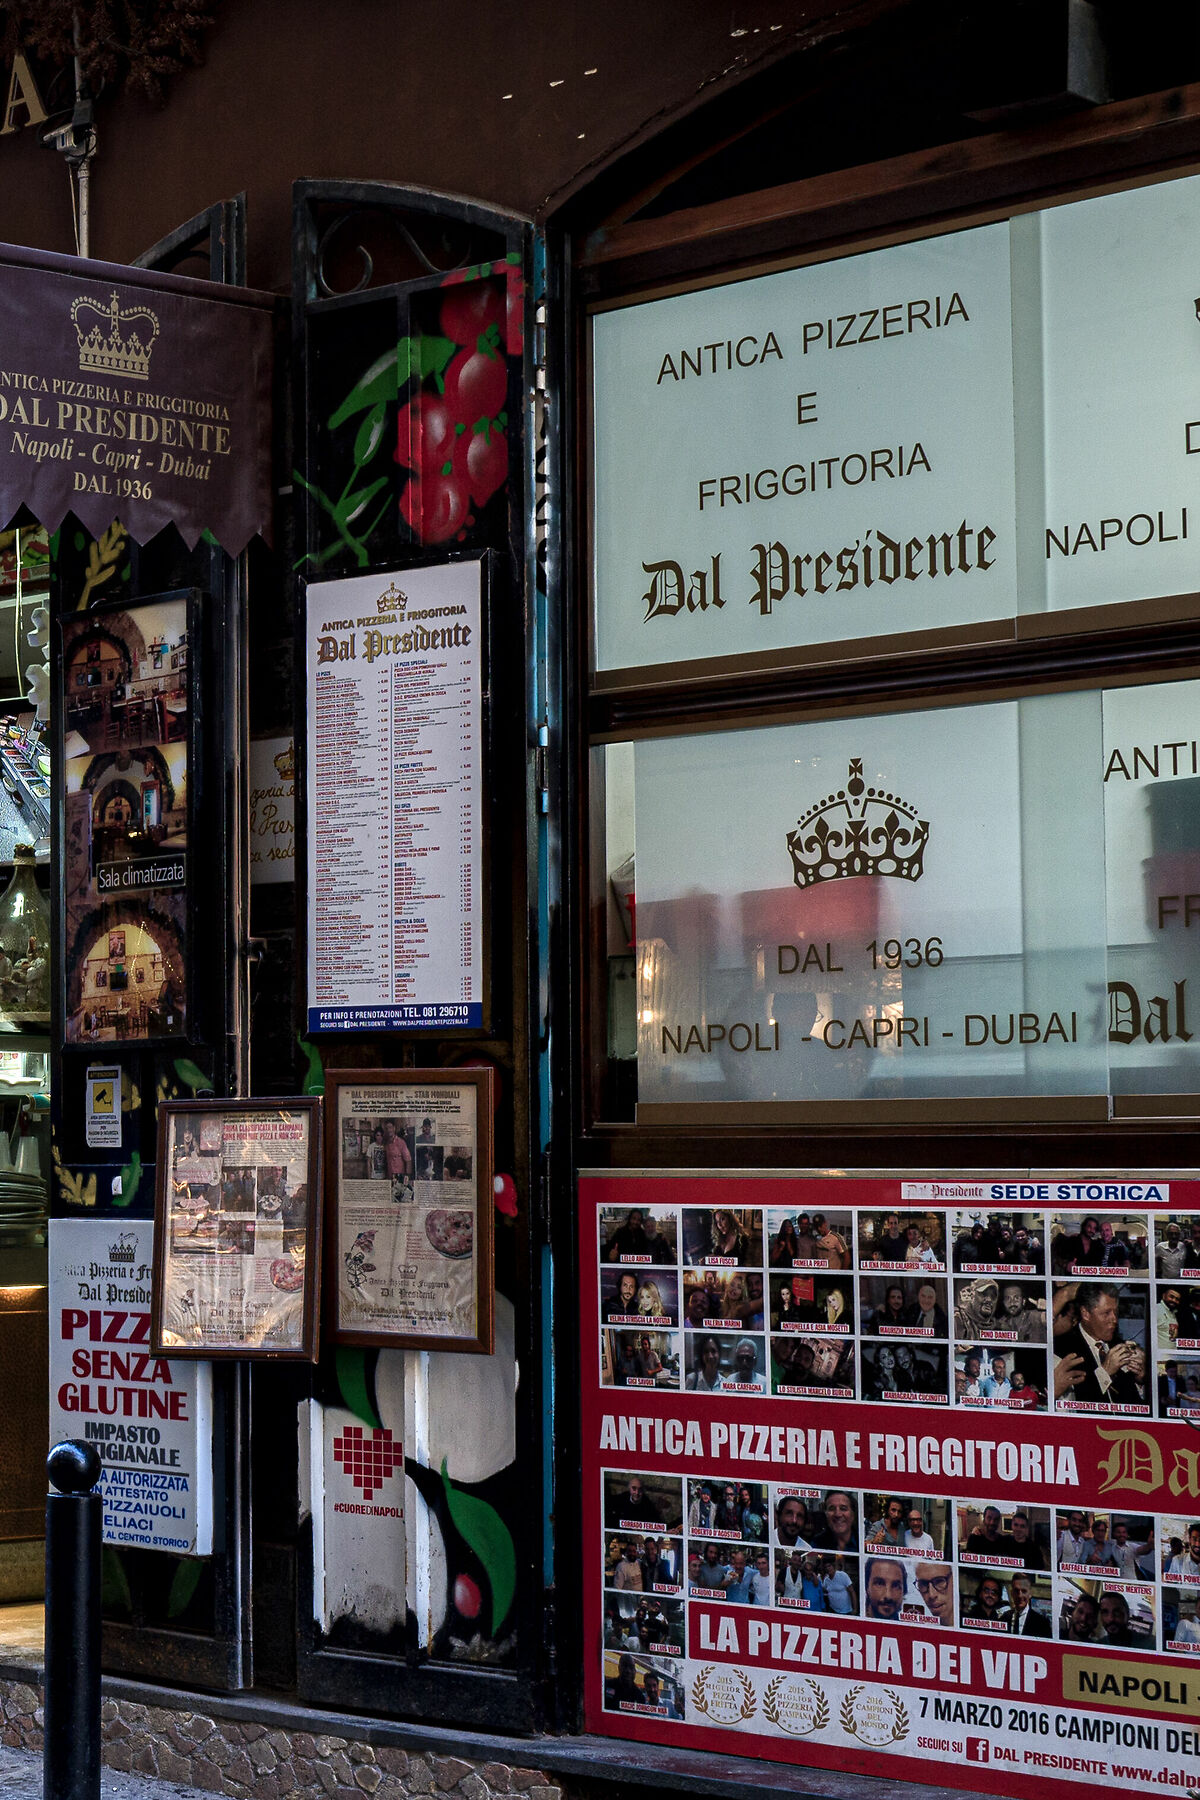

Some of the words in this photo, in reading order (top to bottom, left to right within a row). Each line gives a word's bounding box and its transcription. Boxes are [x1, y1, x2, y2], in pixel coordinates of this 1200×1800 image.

[657, 331, 784, 385] ANTICA
[802, 292, 970, 354] PIZZERIA
[53, 379, 120, 404] PIZZERIA
[124, 390, 133, 405] E
[136, 392, 230, 421] FRIGGITORIA
[796, 392, 818, 424] E
[56, 401, 232, 455] PRESIDENTE
[10, 432, 74, 463] Napoli
[92, 443, 142, 473] Capri
[158, 452, 212, 480] Dubai
[699, 442, 932, 511] FRIGGITORIA
[73, 472, 112, 496] DAL
[115, 478, 152, 500] 1936
[1045, 507, 1188, 559] NAPOLI
[641, 551, 727, 625] Dal
[749, 519, 998, 616] Presidente
[321, 621, 355, 632] ANTICA
[357, 615, 397, 628] PIZZERIA
[399, 613, 405, 622] E
[407, 605, 467, 621] FRIGGITORIA
[316, 633, 356, 665] Dal
[362, 622, 472, 663] Presidente
[99, 867, 120, 888] Sala
[122, 862, 184, 886] climatizzata
[777, 942, 843, 975] DAL
[865, 937, 944, 970] 1936
[320, 1012, 332, 1020] PER
[333, 1011, 348, 1019] INFO
[355, 1010, 402, 1019] PRENOTAZIONI
[403, 1007, 421, 1018] TEL.
[423, 1006, 437, 1017] 081
[439, 1005, 469, 1016] 296710
[1107, 979, 1194, 1045] Dal
[662, 1022, 780, 1054] NAPOLI
[823, 1017, 929, 1050] CAPRI
[964, 1012, 1078, 1046] DUBAI
[351, 1090, 362, 1099] DAL
[363, 1090, 399, 1099] PRESIDENTE
[414, 1090, 429, 1099] STAR
[431, 1090, 460, 1099] MONDIALI
[931, 1184, 984, 1198] Presidente
[990, 1184, 1049, 1200] SEDE
[1057, 1185, 1163, 1200] STORICA
[621, 1255, 635, 1263] LELLO
[635, 1255, 651, 1263] ARENA
[720, 1257, 735, 1265] FUSCO
[814, 1260, 828, 1268] PRATI
[89, 1262, 127, 1280] Pizzeria
[129, 1267, 134, 1278] e
[1072, 1266, 1098, 1275] ALFONSO
[1099, 1267, 1128, 1276] SIGNORINI
[77, 1282, 102, 1301] Dal
[704, 1319, 722, 1327] VALERIA
[723, 1320, 741, 1328] MARINI
[782, 1322, 808, 1331] ANTONELLA
[827, 1324, 848, 1332] MOSETTI
[904, 1328, 934, 1336] MARINELLA
[981, 1331, 995, 1339] PINO
[996, 1331, 1017, 1340] DANIELE
[1177, 1339, 1195, 1347] DIEGO
[72, 1348, 173, 1384] SENZA
[723, 1382, 737, 1390] MARA
[737, 1383, 762, 1391] CARFAGNA
[58, 1382, 189, 1421] GLUTINE
[883, 1392, 917, 1401] MARIAGRAZIA
[918, 1393, 947, 1402] CUCINOTTA
[961, 1397, 984, 1405] SINDACO
[994, 1398, 1023, 1407] MAGISTRIS
[1063, 1401, 1097, 1411] PRESIDENTE
[1110, 1403, 1122, 1412] BILL
[1123, 1404, 1149, 1413] CLINTON
[84, 1421, 161, 1444] IMPASTO
[599, 1414, 704, 1457] ANTICA
[711, 1421, 838, 1468] PIZZERIA
[846, 1431, 861, 1469] E
[869, 1432, 1080, 1486] FRIGGITORIA
[111, 1470, 189, 1492] AUTORIZZATA
[105, 1486, 169, 1502] ATTESTATO
[777, 1488, 797, 1497] CRISTIAN
[807, 1490, 819, 1498] SICA
[106, 1529, 117, 1539] AL
[118, 1532, 152, 1544] CENTRO
[152, 1536, 189, 1548] STORICO
[876, 1545, 897, 1555] STILISTA
[926, 1549, 943, 1559] DOLCE
[962, 1553, 978, 1562] FIGLIO
[986, 1555, 999, 1564] PINO
[1000, 1556, 1023, 1566] DANIELE
[1061, 1563, 1087, 1573] RAFFAELE
[1088, 1565, 1119, 1576] AURIEMMA
[1165, 1573, 1182, 1581] ROMA
[691, 1588, 709, 1597] CLAUDIO
[1104, 1583, 1124, 1592] DRIESS
[1125, 1585, 1152, 1595] MERTENS
[963, 1618, 989, 1628] ARKADIUS
[1167, 1641, 1190, 1650] MARINO
[700, 1613, 740, 1653] LA
[748, 1619, 902, 1676] PIZZERIA
[912, 1643, 972, 1685] DEI
[980, 1648, 1048, 1694] VIP
[716, 1675, 733, 1685] 2015
[705, 1683, 741, 1694] MIGLIOR
[788, 1685, 805, 1694] 2015
[1078, 1670, 1188, 1705] NAPOLI
[712, 1691, 736, 1701] PIZZA
[777, 1692, 813, 1703] MIGLIOR
[866, 1695, 883, 1705] 2016
[710, 1700, 738, 1710] FRITTA
[777, 1701, 814, 1713] PIZZERIA
[856, 1703, 893, 1715] CAMPIONI
[779, 1709, 812, 1721] CAMPANA
[866, 1712, 882, 1722] DEL
[860, 1720, 889, 1730] MONDO
[919, 1697, 928, 1718] 7
[933, 1698, 1003, 1730] MARZO
[1008, 1706, 1049, 1736] 2016
[1055, 1714, 1159, 1751] CAMPIONI
[917, 1736, 949, 1752] SEGUICI
[951, 1740, 963, 1754] SU
[993, 1745, 1020, 1762] DAL
[1024, 1750, 1107, 1777] PRESIDENTE
